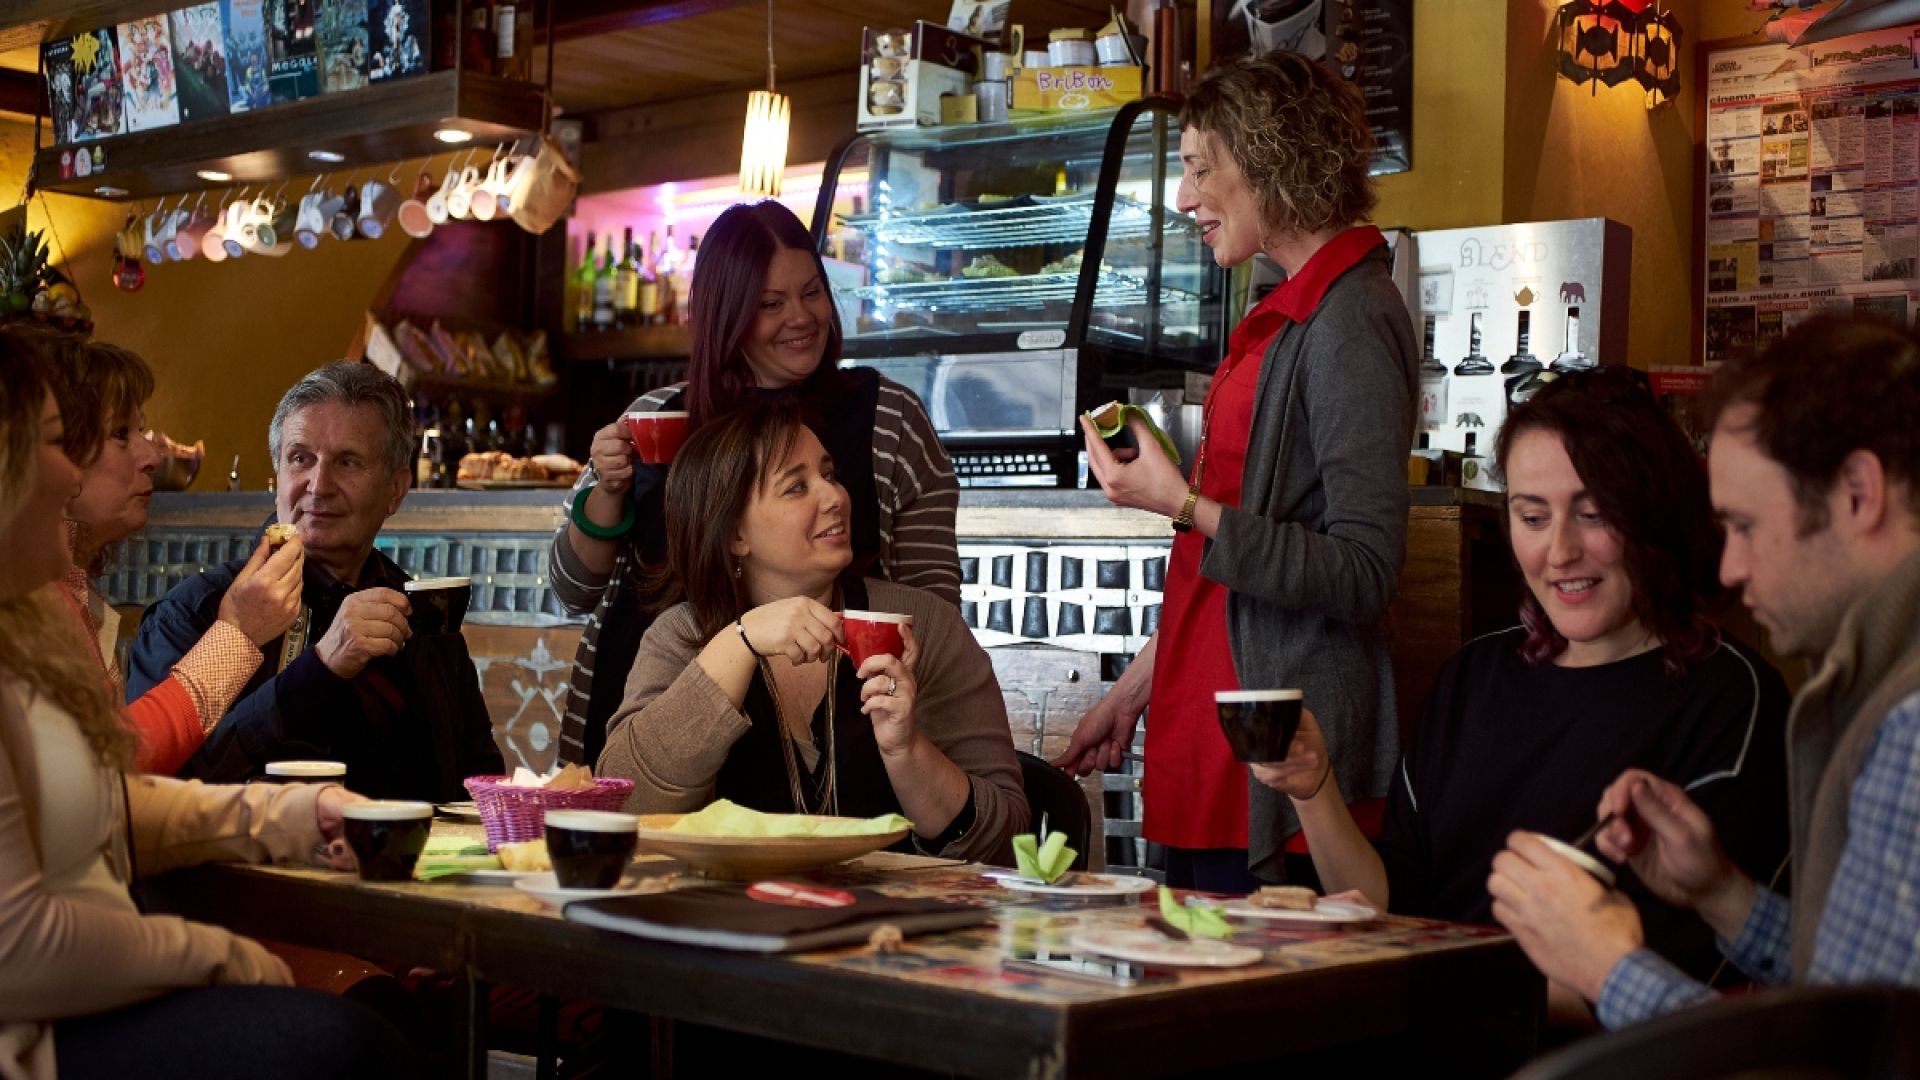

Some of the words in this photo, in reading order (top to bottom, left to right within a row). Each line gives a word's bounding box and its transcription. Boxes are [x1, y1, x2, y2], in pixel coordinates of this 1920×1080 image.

[1039, 71, 1113, 90] BriBon
[1709, 94, 1756, 104] cinema
[1459, 237, 1548, 270] BLEND
